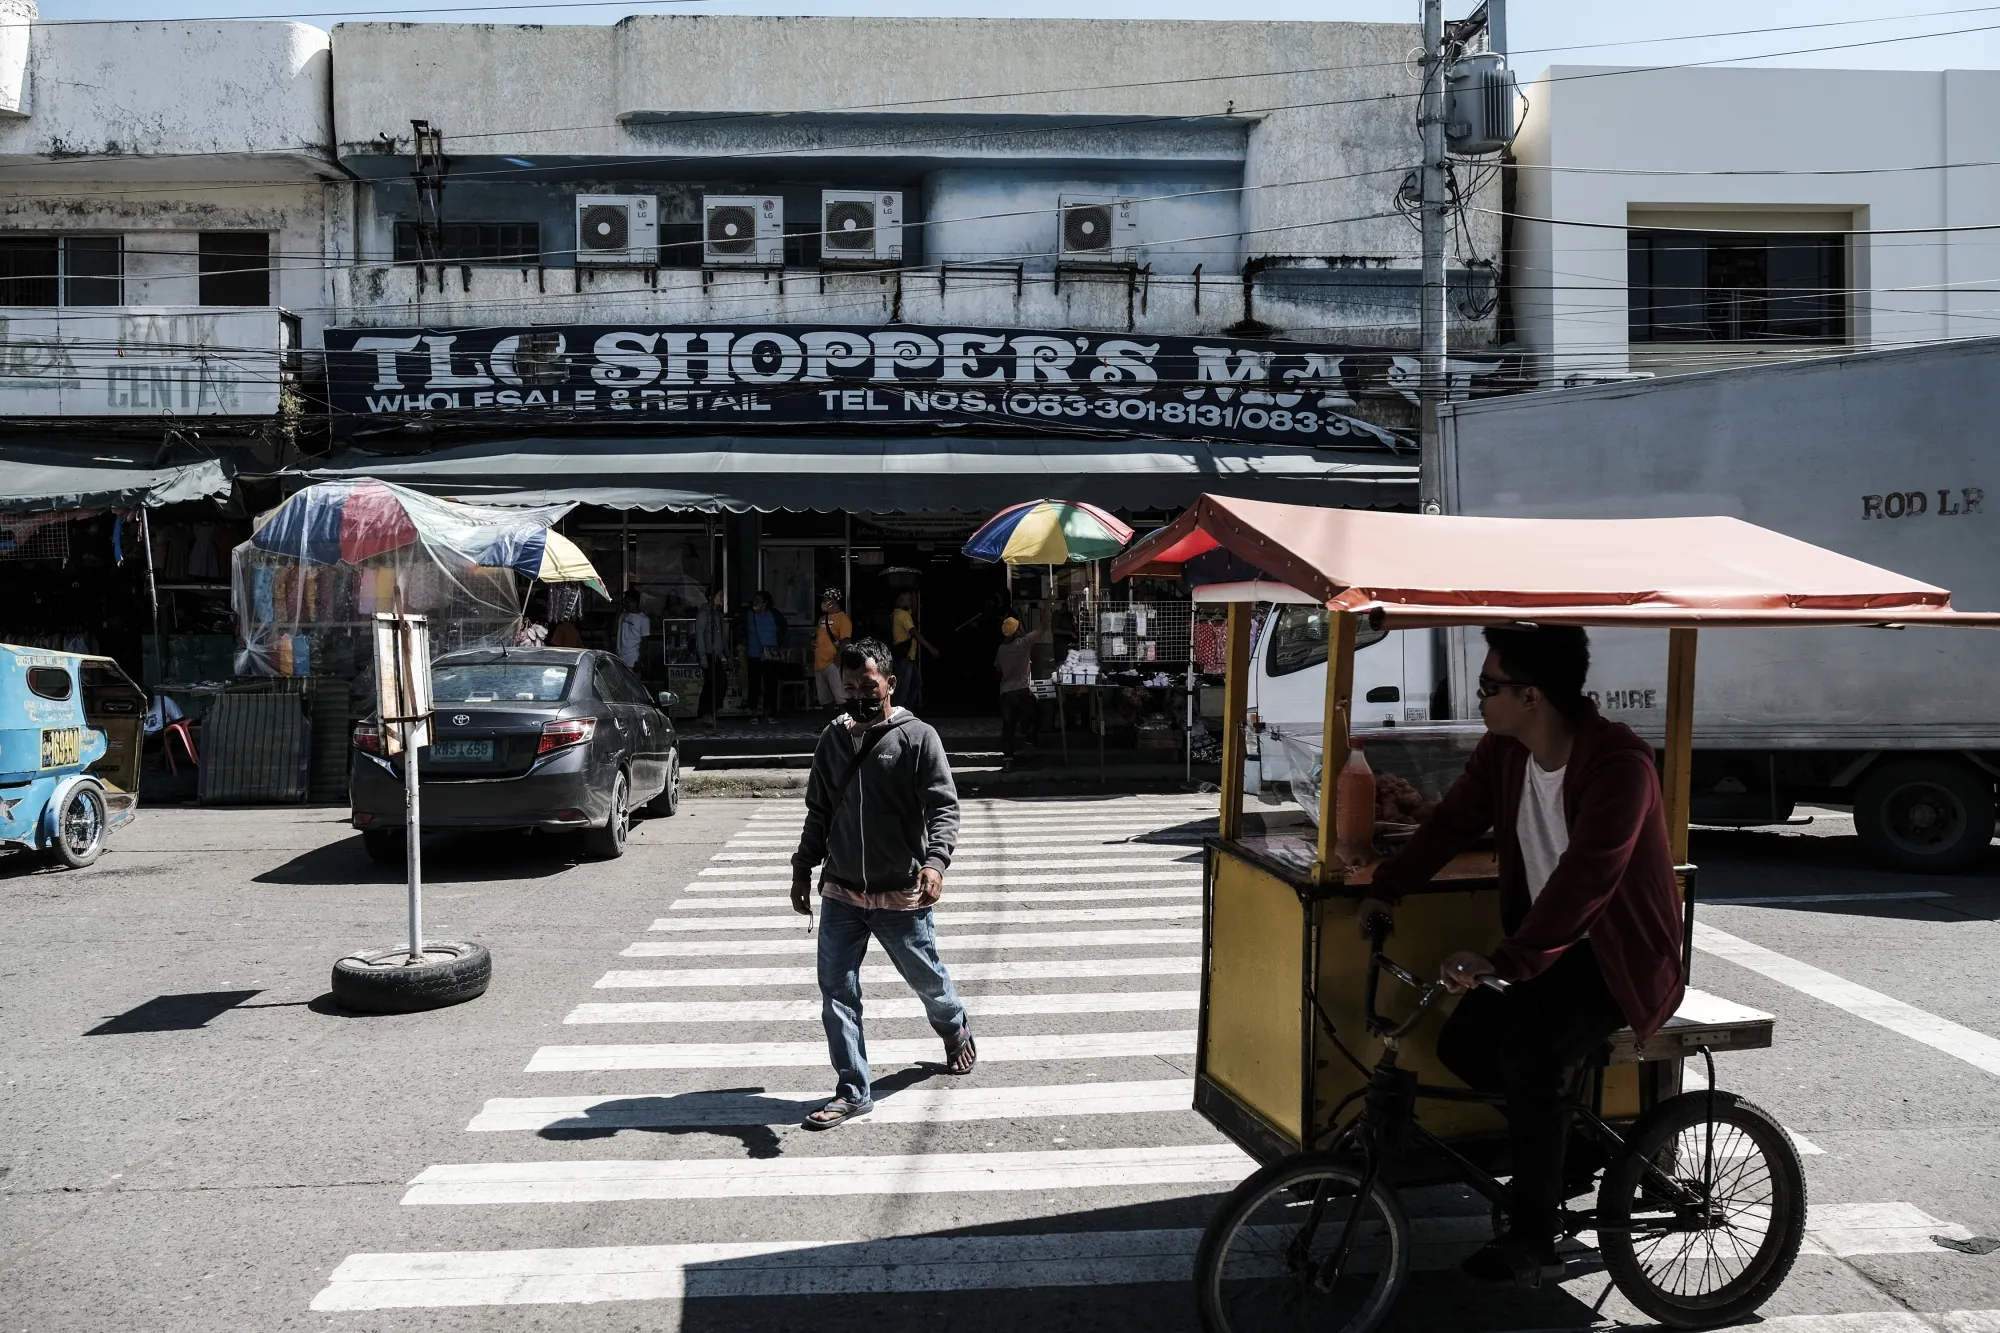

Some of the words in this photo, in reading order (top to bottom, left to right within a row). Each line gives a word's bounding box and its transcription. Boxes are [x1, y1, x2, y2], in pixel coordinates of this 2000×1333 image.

[590, 332, 1160, 396] SHOPPER'S
[365, 390, 596, 414] WHOLESALE
[610, 389, 634, 412] &
[820, 389, 889, 411] TEL
[904, 391, 997, 412] NOS.
[1862, 491, 1928, 520] ROD
[1606, 690, 1657, 709] HIRE
